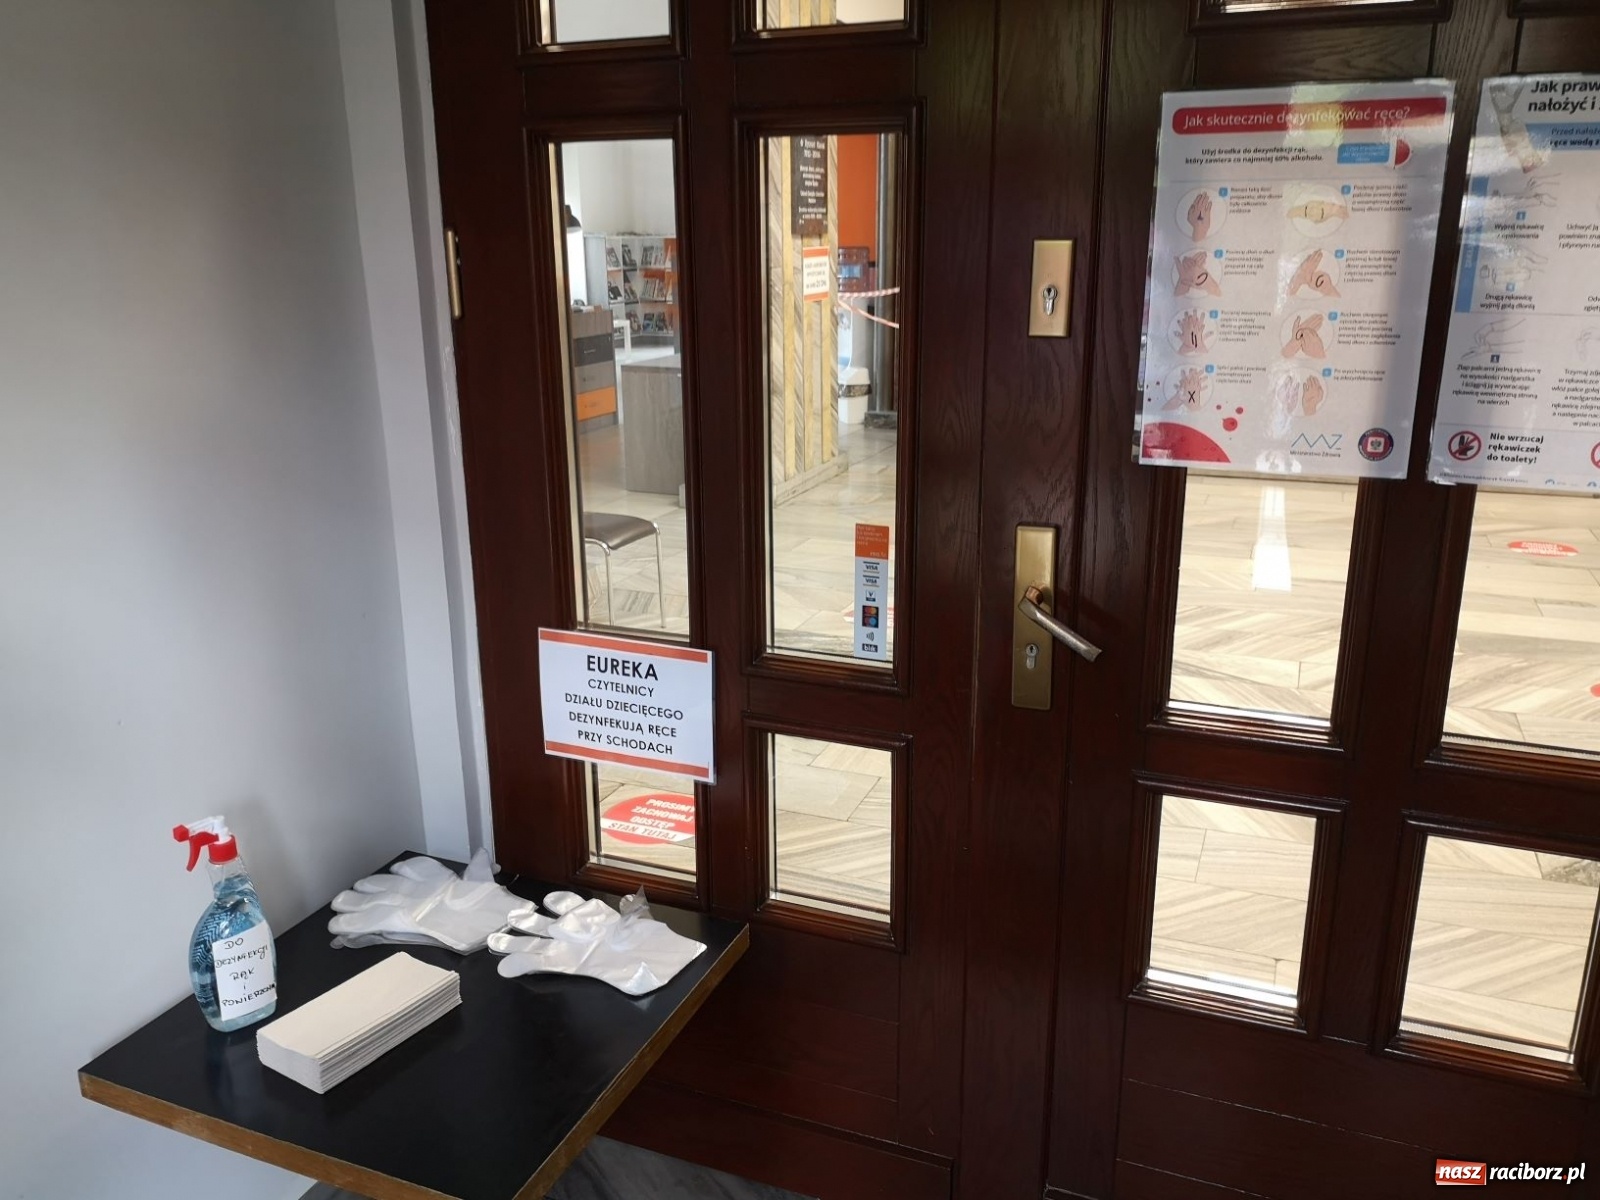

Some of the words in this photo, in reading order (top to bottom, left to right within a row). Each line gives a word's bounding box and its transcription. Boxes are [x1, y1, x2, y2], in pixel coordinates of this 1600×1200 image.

[1530, 81, 1558, 93] Jak
[1528, 96, 1588, 114] nałożyć
[1183, 114, 1203, 129] Jak
[1206, 111, 1274, 126] skutecznie
[1374, 106, 1411, 123] ręce?
[1185, 157, 1204, 165] który
[1243, 156, 1273, 164] najmniej
[1490, 433, 1505, 441] Nie
[1507, 434, 1544, 444] wrzucaj
[1488, 444, 1541, 453] rękawiczek
[1500, 455, 1537, 465] toalety!
[587, 654, 658, 681] EUREKA
[587, 678, 655, 698] CZYTELNICY
[564, 692, 602, 708] DZIAŁU
[606, 699, 683, 721] DZIECIĘCEGO
[568, 711, 644, 735] DEZYNFEKUJĄ
[648, 724, 677, 738] RĘCE
[577, 729, 602, 743] PRZY
[606, 734, 673, 755] SCHODACH
[608, 822, 638, 833] STAN
[641, 827, 677, 840] TUTAJ
[224, 937, 244, 950] DO
